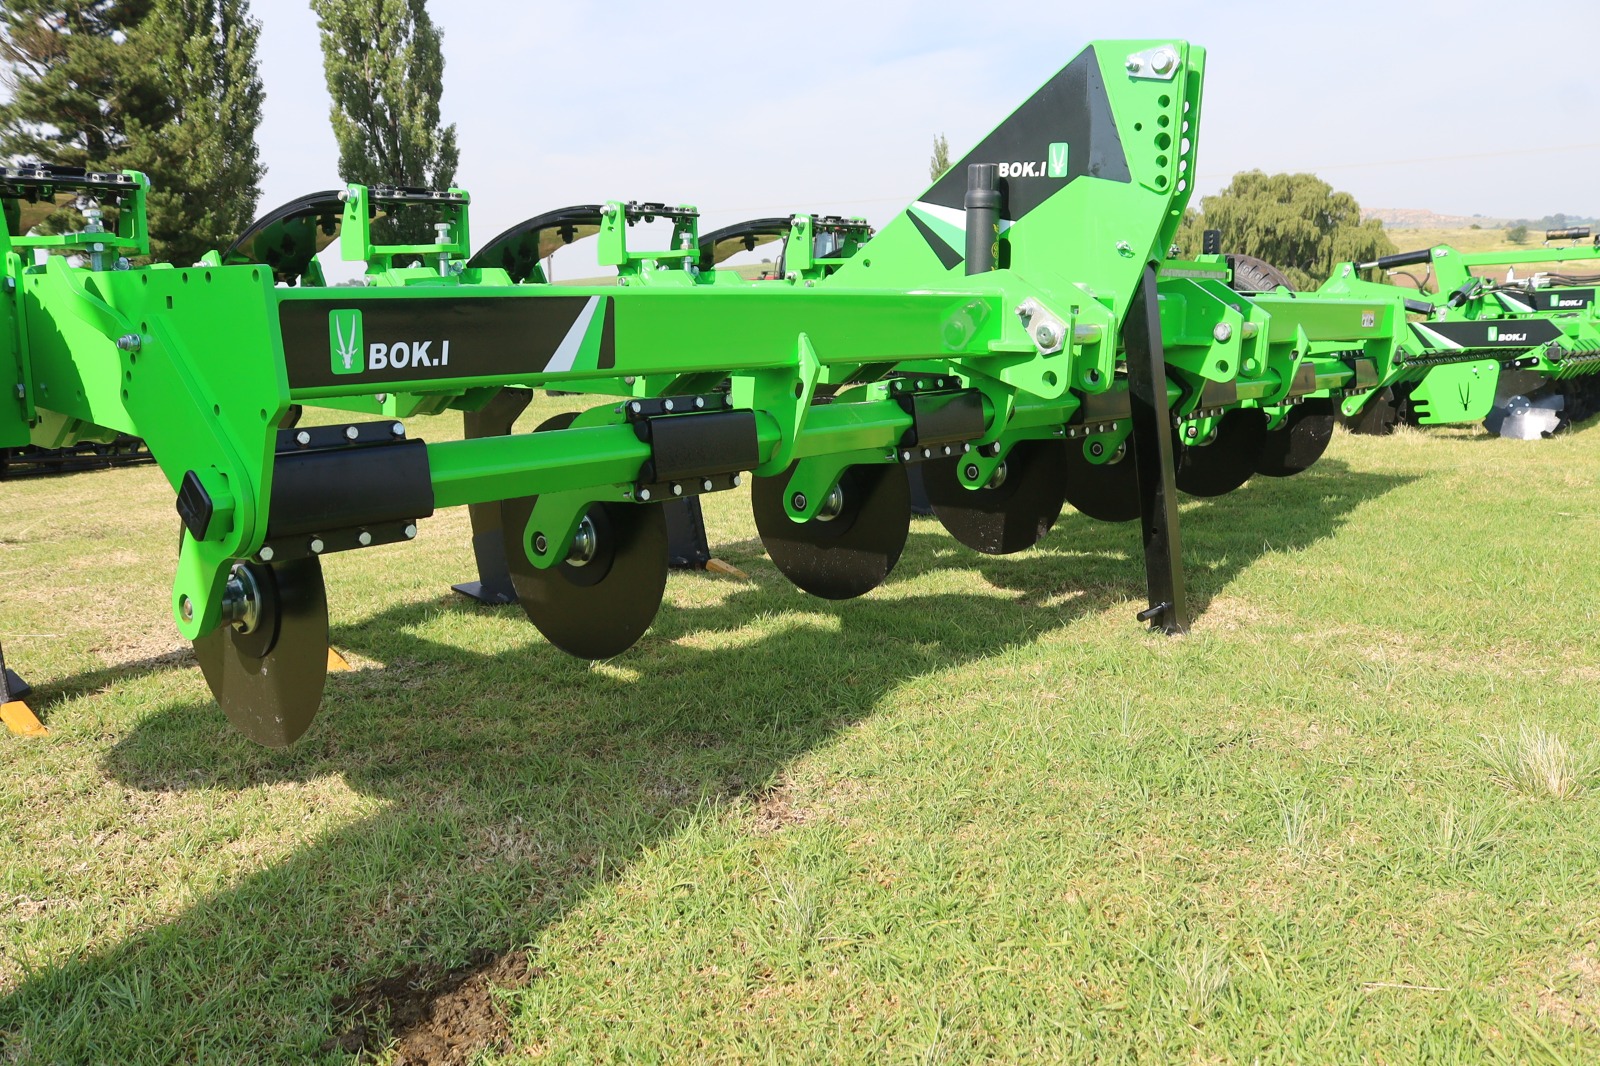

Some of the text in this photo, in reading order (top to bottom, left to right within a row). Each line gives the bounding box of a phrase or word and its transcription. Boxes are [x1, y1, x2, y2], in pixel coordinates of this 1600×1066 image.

[998, 161, 1047, 177] BOK.I
[1498, 333, 1527, 342] BOK.I
[368, 340, 450, 370] BOK.I
